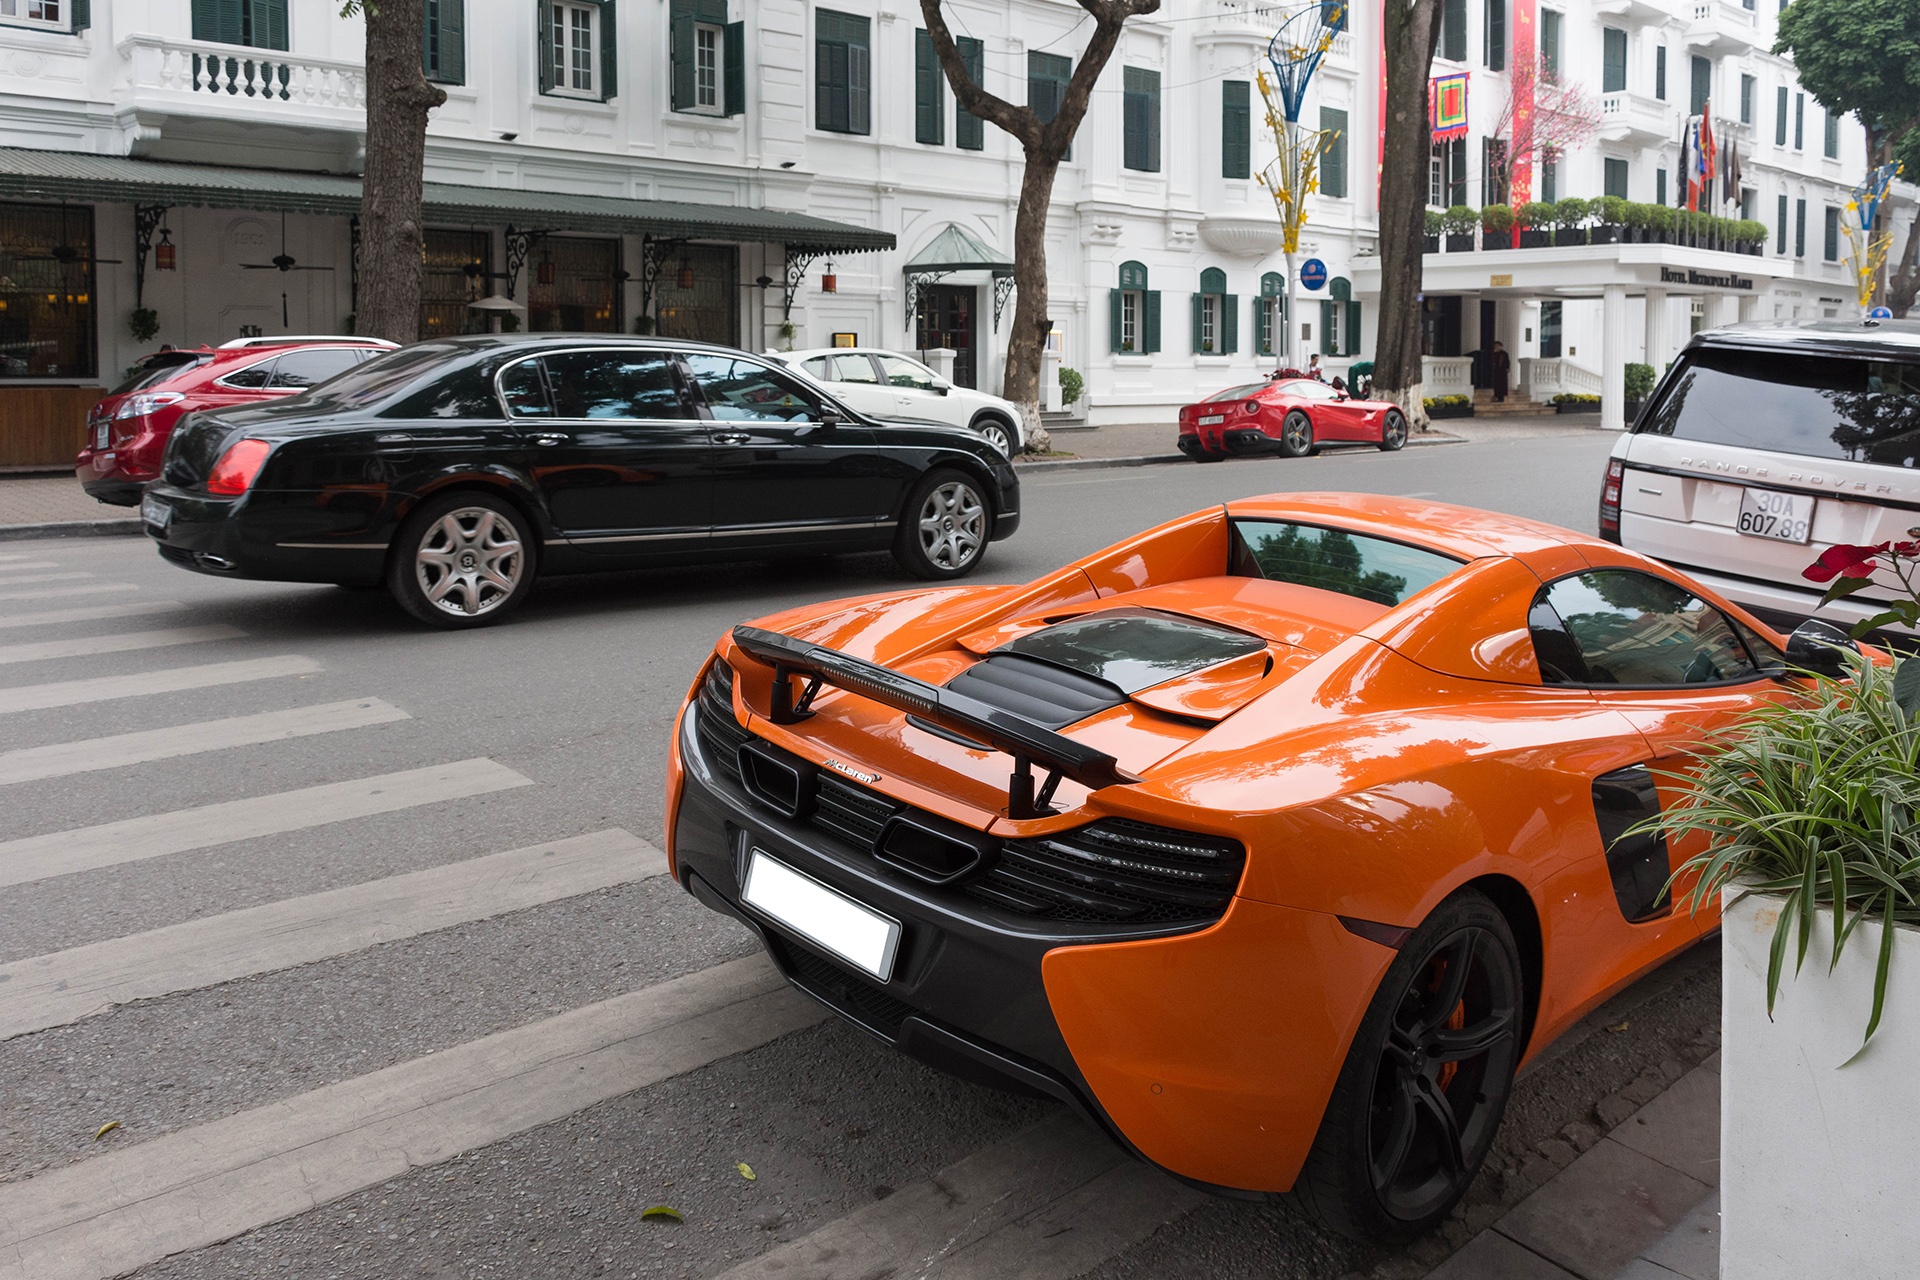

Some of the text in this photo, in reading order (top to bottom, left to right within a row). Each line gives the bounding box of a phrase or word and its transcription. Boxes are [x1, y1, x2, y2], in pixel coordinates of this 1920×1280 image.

[1680, 456, 1891, 494] RANGE ROVER
[1757, 492, 1794, 517] 30A
[1740, 511, 1807, 541] 607.88
[823, 758, 873, 784] McLaren
